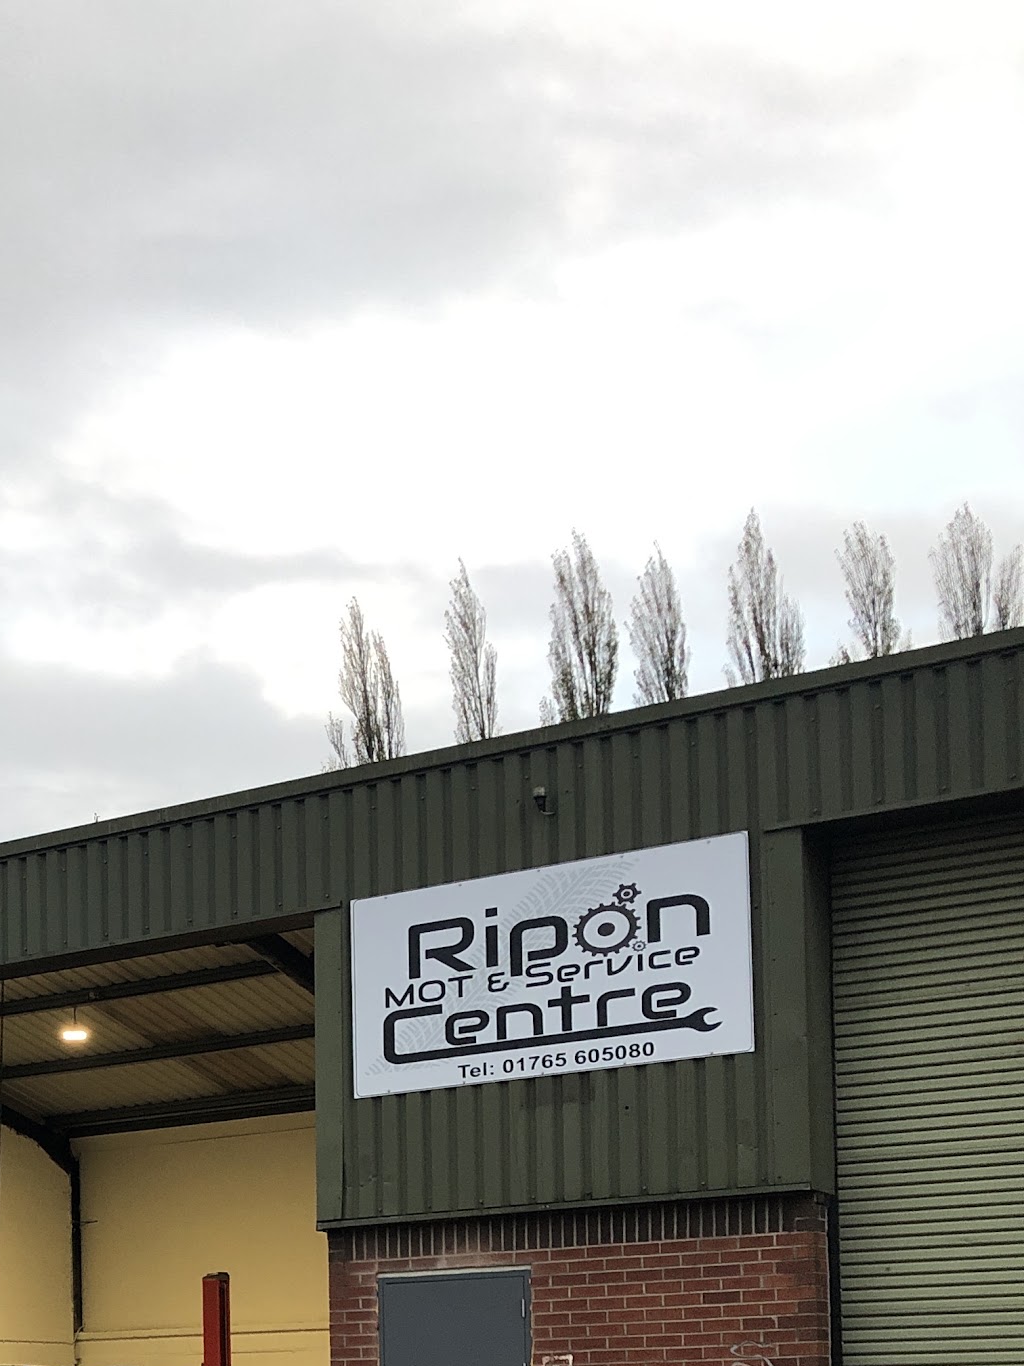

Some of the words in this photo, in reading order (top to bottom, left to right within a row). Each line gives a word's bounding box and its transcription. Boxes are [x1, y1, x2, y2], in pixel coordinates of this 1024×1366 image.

[408, 893, 710, 979] Ripon
[386, 976, 477, 1008] MOT
[487, 972, 509, 993] &
[526, 945, 700, 988] Service
[383, 982, 706, 1064] Centre
[458, 1063, 494, 1080] Tel:
[503, 1052, 566, 1074] 01765
[574, 1042, 655, 1063] 605080
